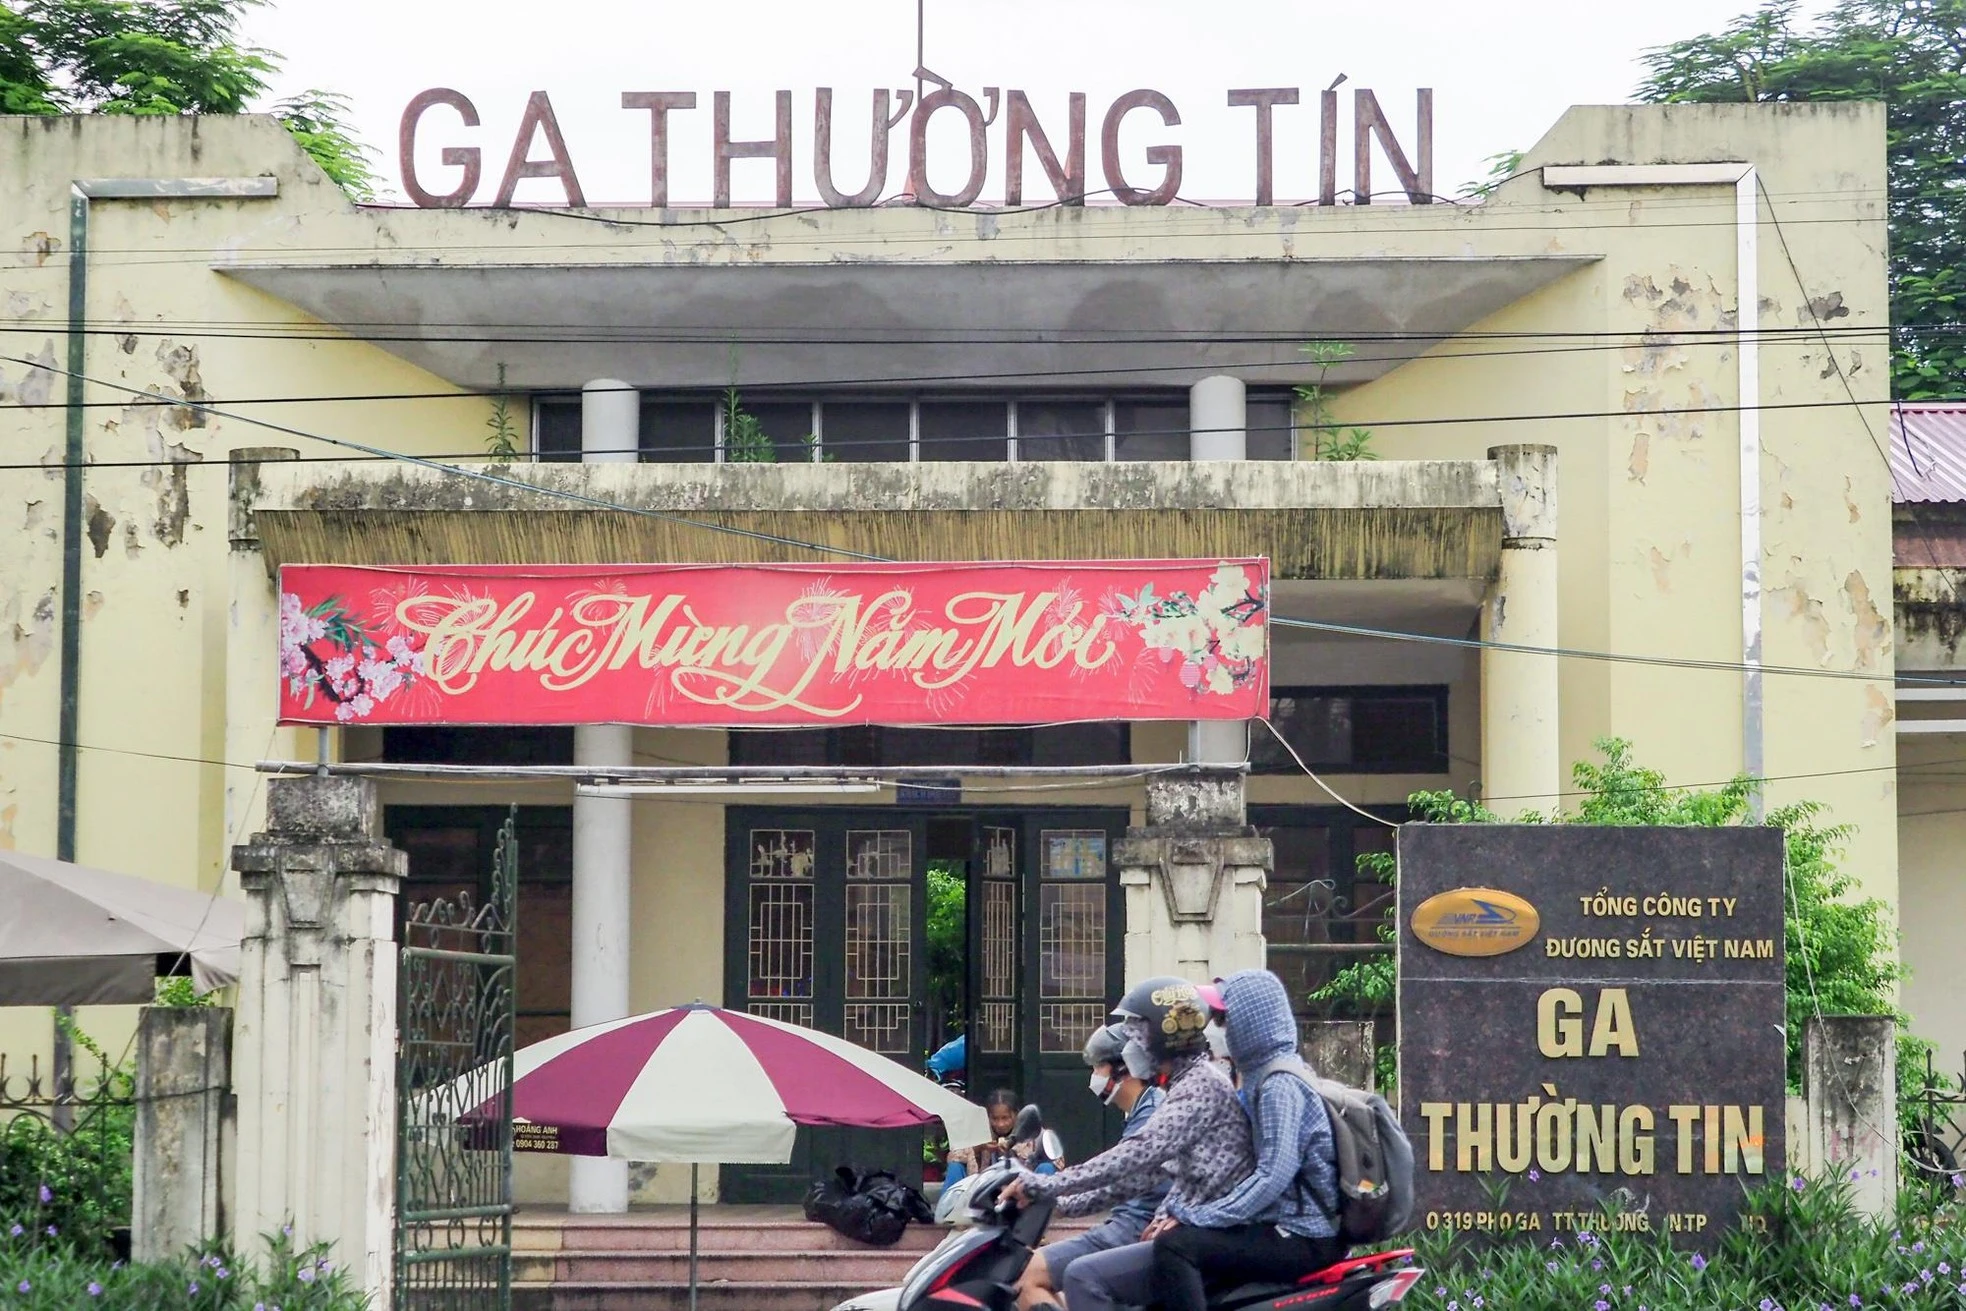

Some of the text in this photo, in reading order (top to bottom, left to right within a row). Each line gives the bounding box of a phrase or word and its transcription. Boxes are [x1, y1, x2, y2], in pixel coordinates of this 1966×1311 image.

[399, 65, 1432, 208] GA THƯỜNG TÍN
[395, 591, 596, 695] Chúc
[540, 594, 862, 717] Mừng
[913, 592, 1116, 689] Mới
[1580, 886, 1637, 916] TỔNG
[1643, 892, 1701, 917] CÔNG
[1626, 928, 1665, 958] SẮT
[1672, 935, 1718, 963] VIỆT
[1724, 939, 1774, 959] NAM
[1536, 988, 1640, 1058] GA
[1421, 1083, 1764, 1175] THƯỜNG TIN
